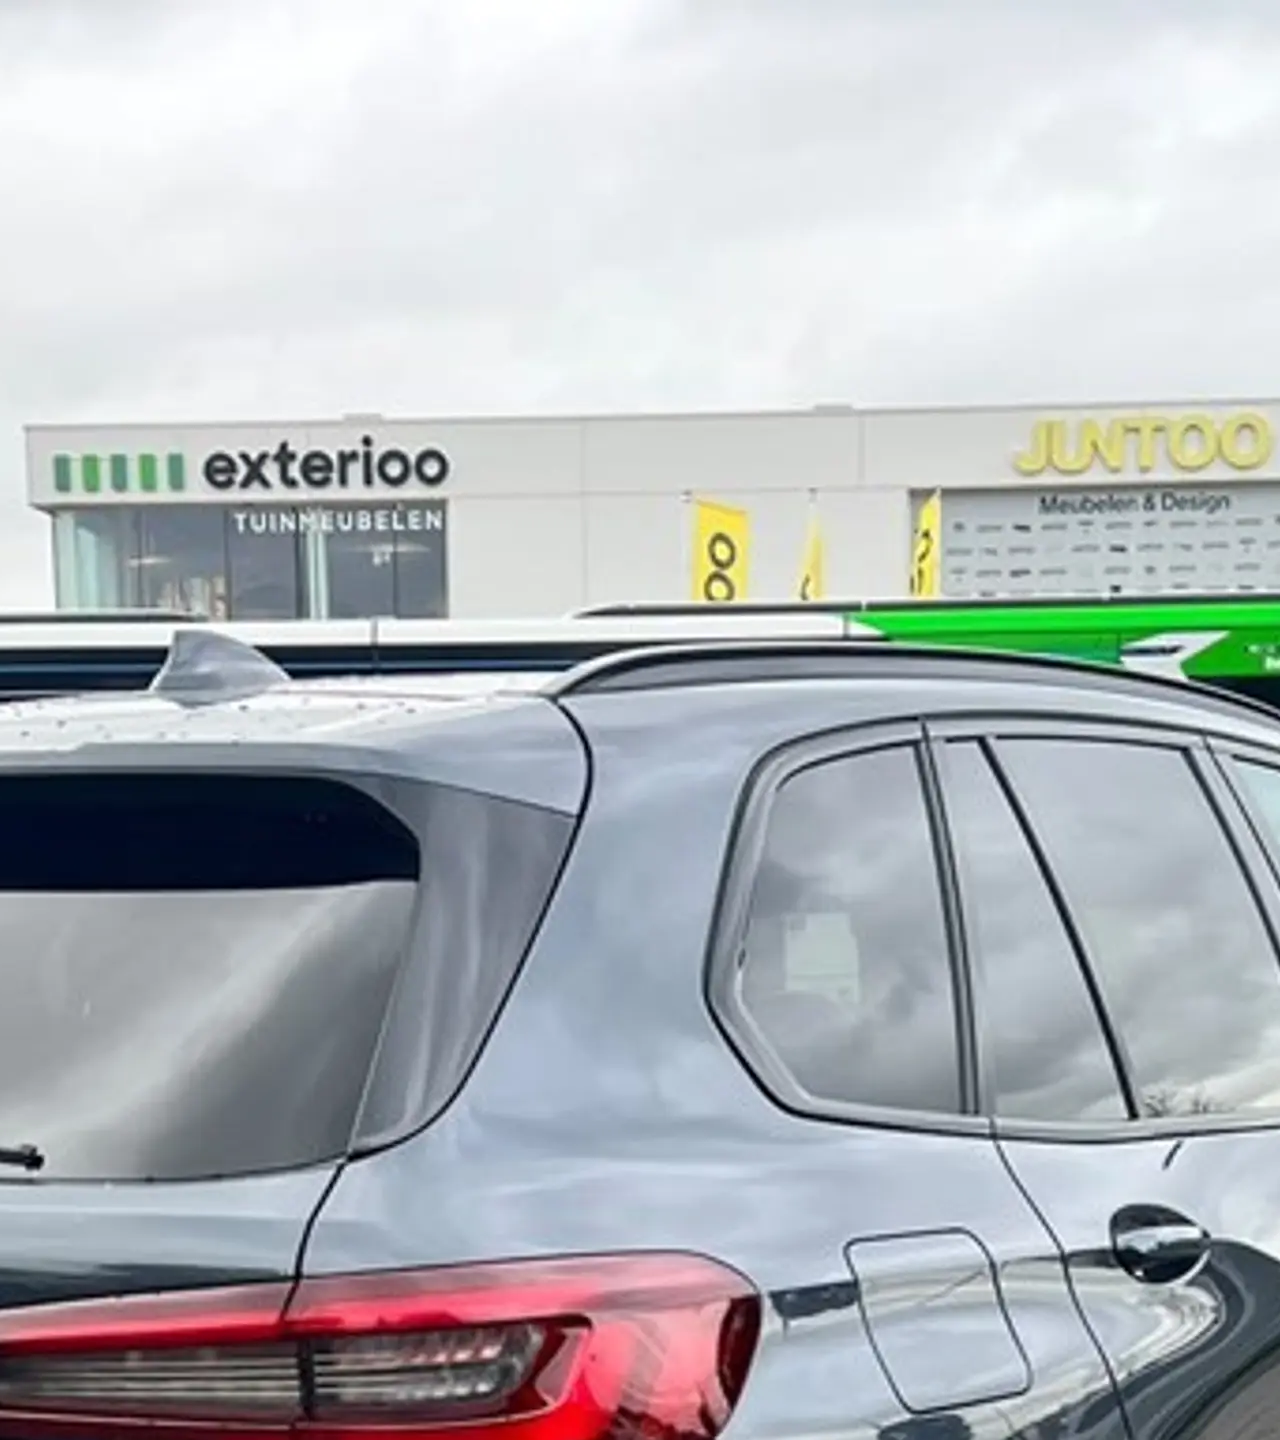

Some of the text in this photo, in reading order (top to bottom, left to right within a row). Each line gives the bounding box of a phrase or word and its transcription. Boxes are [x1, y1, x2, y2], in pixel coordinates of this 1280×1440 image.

[204, 434, 449, 489] exterioo
[1014, 413, 1272, 476] JUNTOO
[235, 510, 444, 534] TUINMEUBELEN
[1037, 490, 1231, 515] Meubelen & Design
